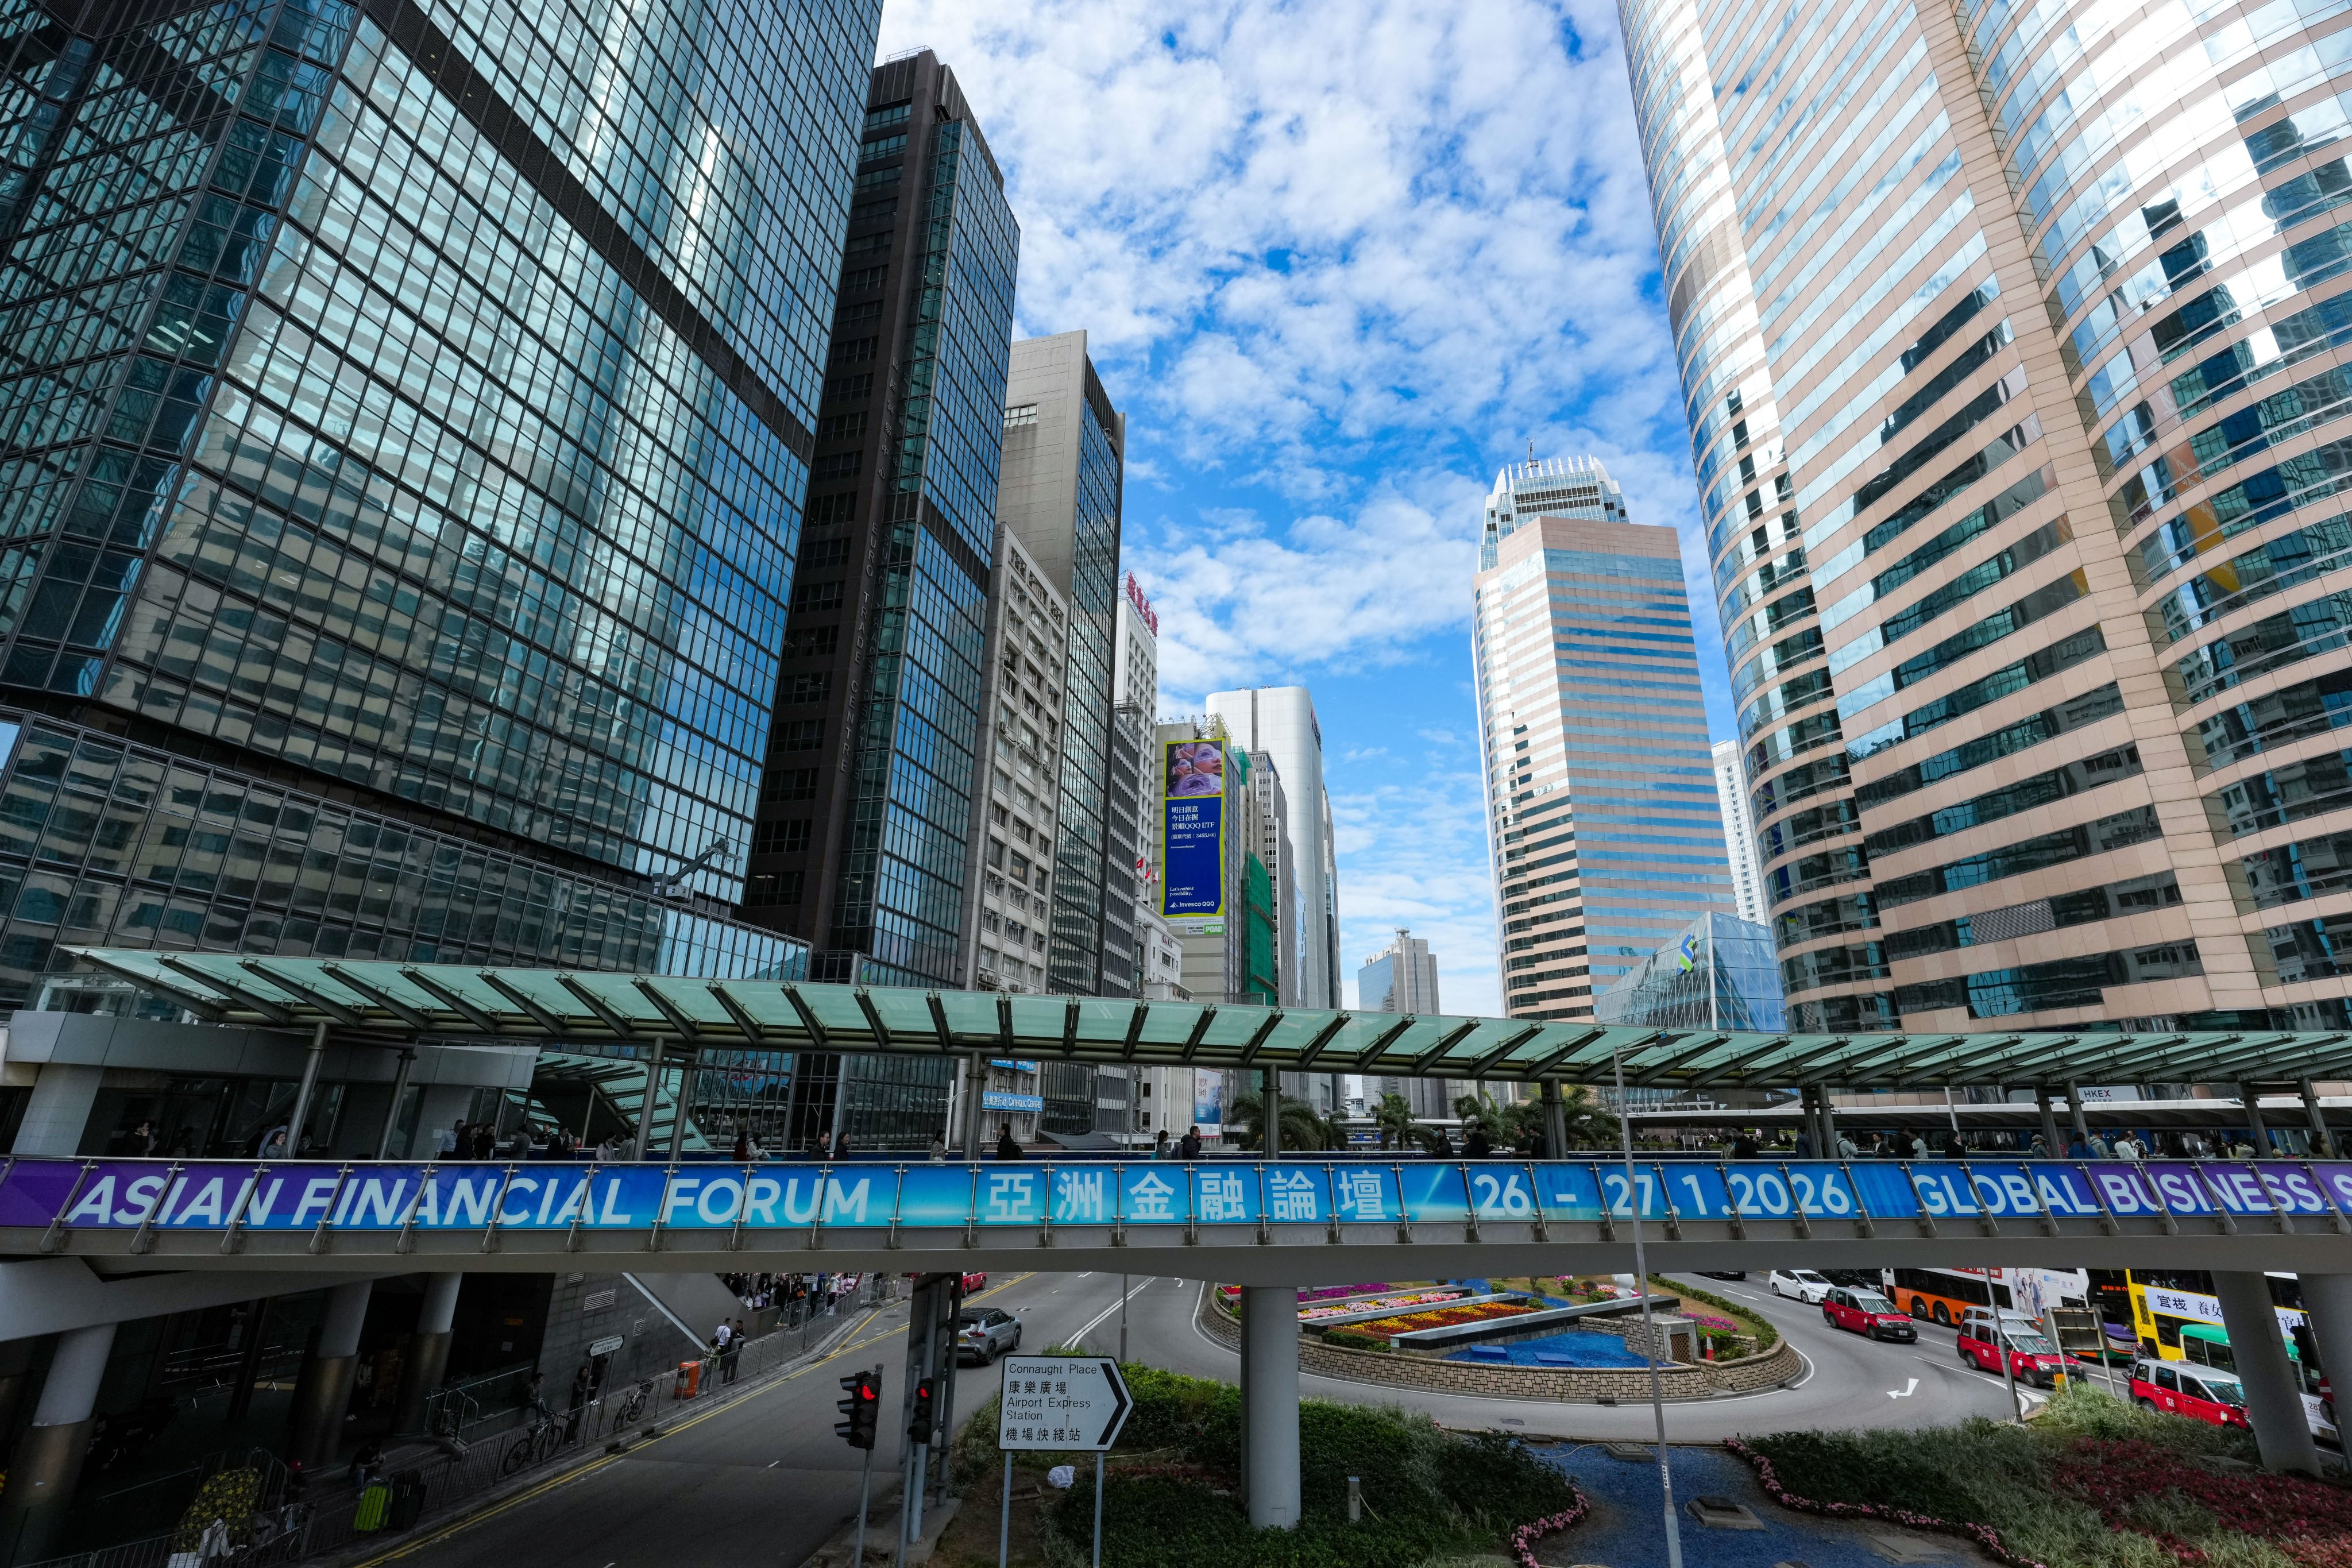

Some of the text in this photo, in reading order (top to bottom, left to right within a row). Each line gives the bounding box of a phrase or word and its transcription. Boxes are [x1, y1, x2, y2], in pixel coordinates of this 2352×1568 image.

[1172, 805, 1199, 814] 明日創意
[1172, 813, 1199, 822] 今日在握
[2084, 1090, 2111, 1098] HKEX
[65, 1175, 285, 1226] ASIAN
[291, 1177, 632, 1226] FINANCIAL
[663, 1177, 871, 1224] FORUM
[985, 1169, 1387, 1222] 亞洲金融論壇
[1473, 1174, 1532, 1217] 26
[1911, 1174, 2102, 1218] GLOBAL
[2098, 1173, 2330, 1216] BUSINESS
[1009, 1363, 1098, 1376] Connaught Place
[1008, 1380, 1068, 1395] 康樂廣場
[1006, 1397, 1091, 1409] Airport Express
[1006, 1410, 1044, 1421] Station
[1005, 1426, 1081, 1442] 機場快綫站
